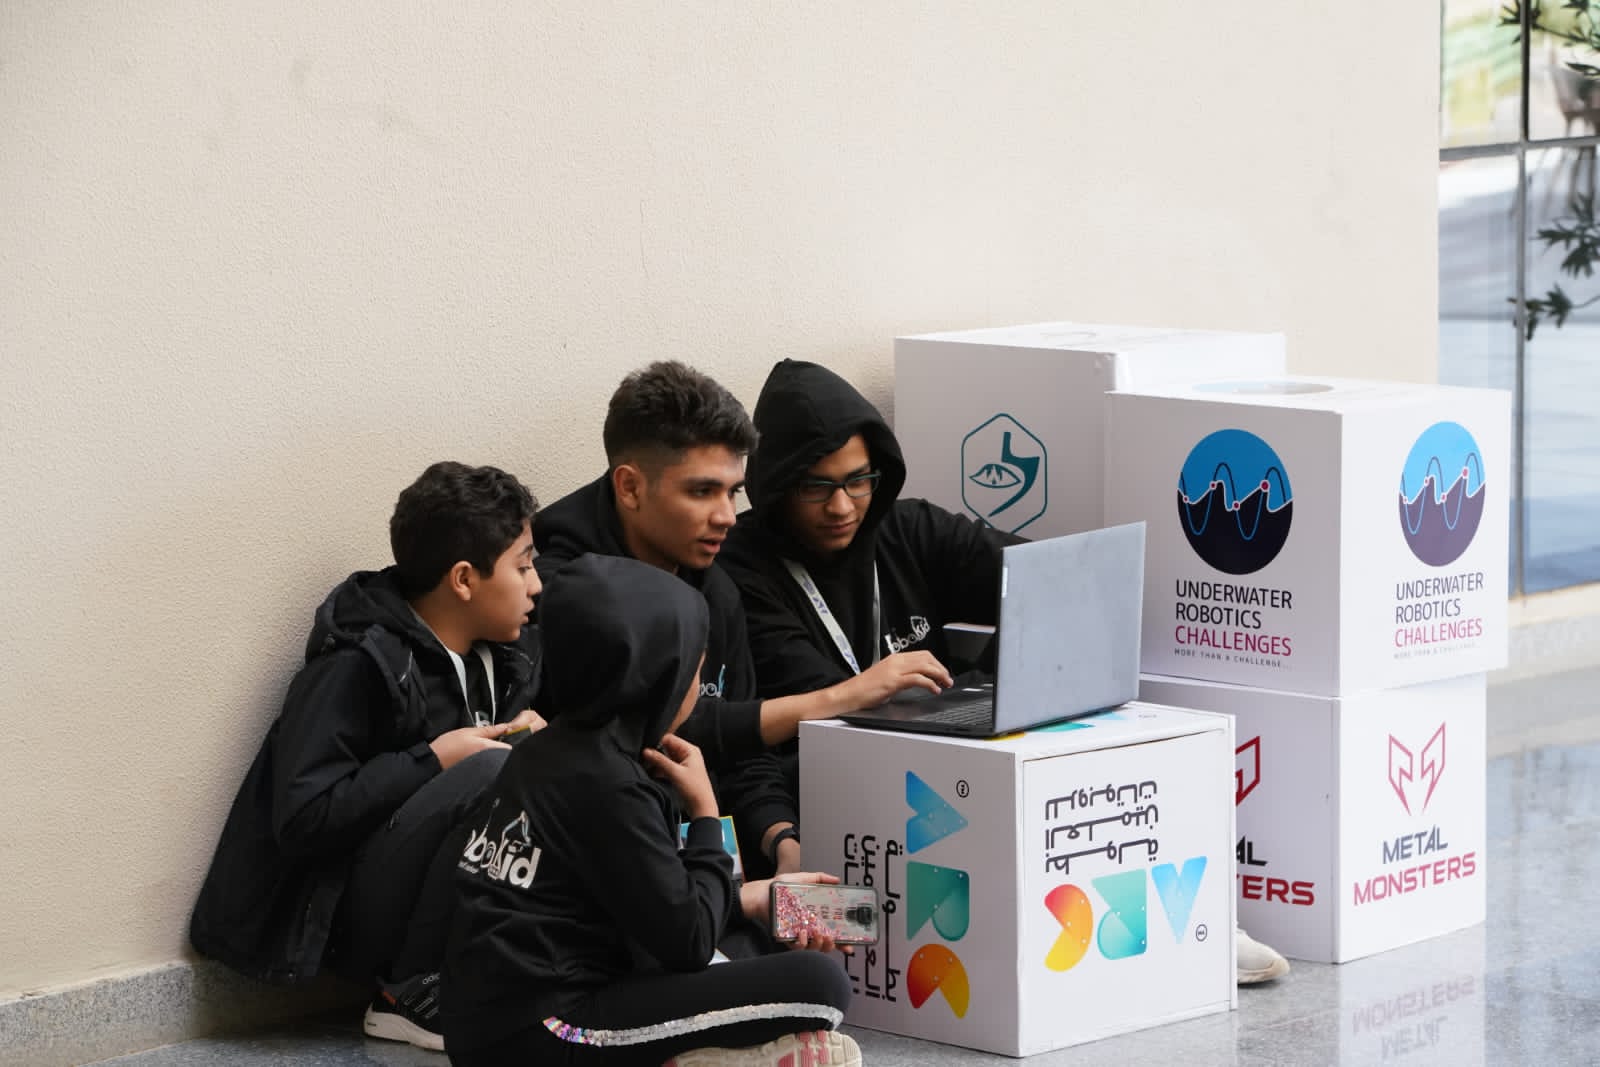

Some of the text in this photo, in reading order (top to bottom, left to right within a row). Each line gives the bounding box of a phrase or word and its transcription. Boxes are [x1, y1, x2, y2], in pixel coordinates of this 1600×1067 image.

[1176, 579, 1292, 610] UNDERWATER
[1396, 571, 1484, 601] UNDERWATER
[1176, 602, 1262, 629] ROBOTICS
[1395, 598, 1461, 624] ROBOTICS
[1175, 625, 1292, 657] CHALLENGES
[1395, 618, 1482, 648] CHALLENGES
[1174, 647, 1196, 657] MORE
[1200, 651, 1222, 661] THAN
[1045, 838, 1159, 875] بطولة
[1382, 824, 1448, 865] METAL
[1353, 852, 1476, 906] MONSTERS
